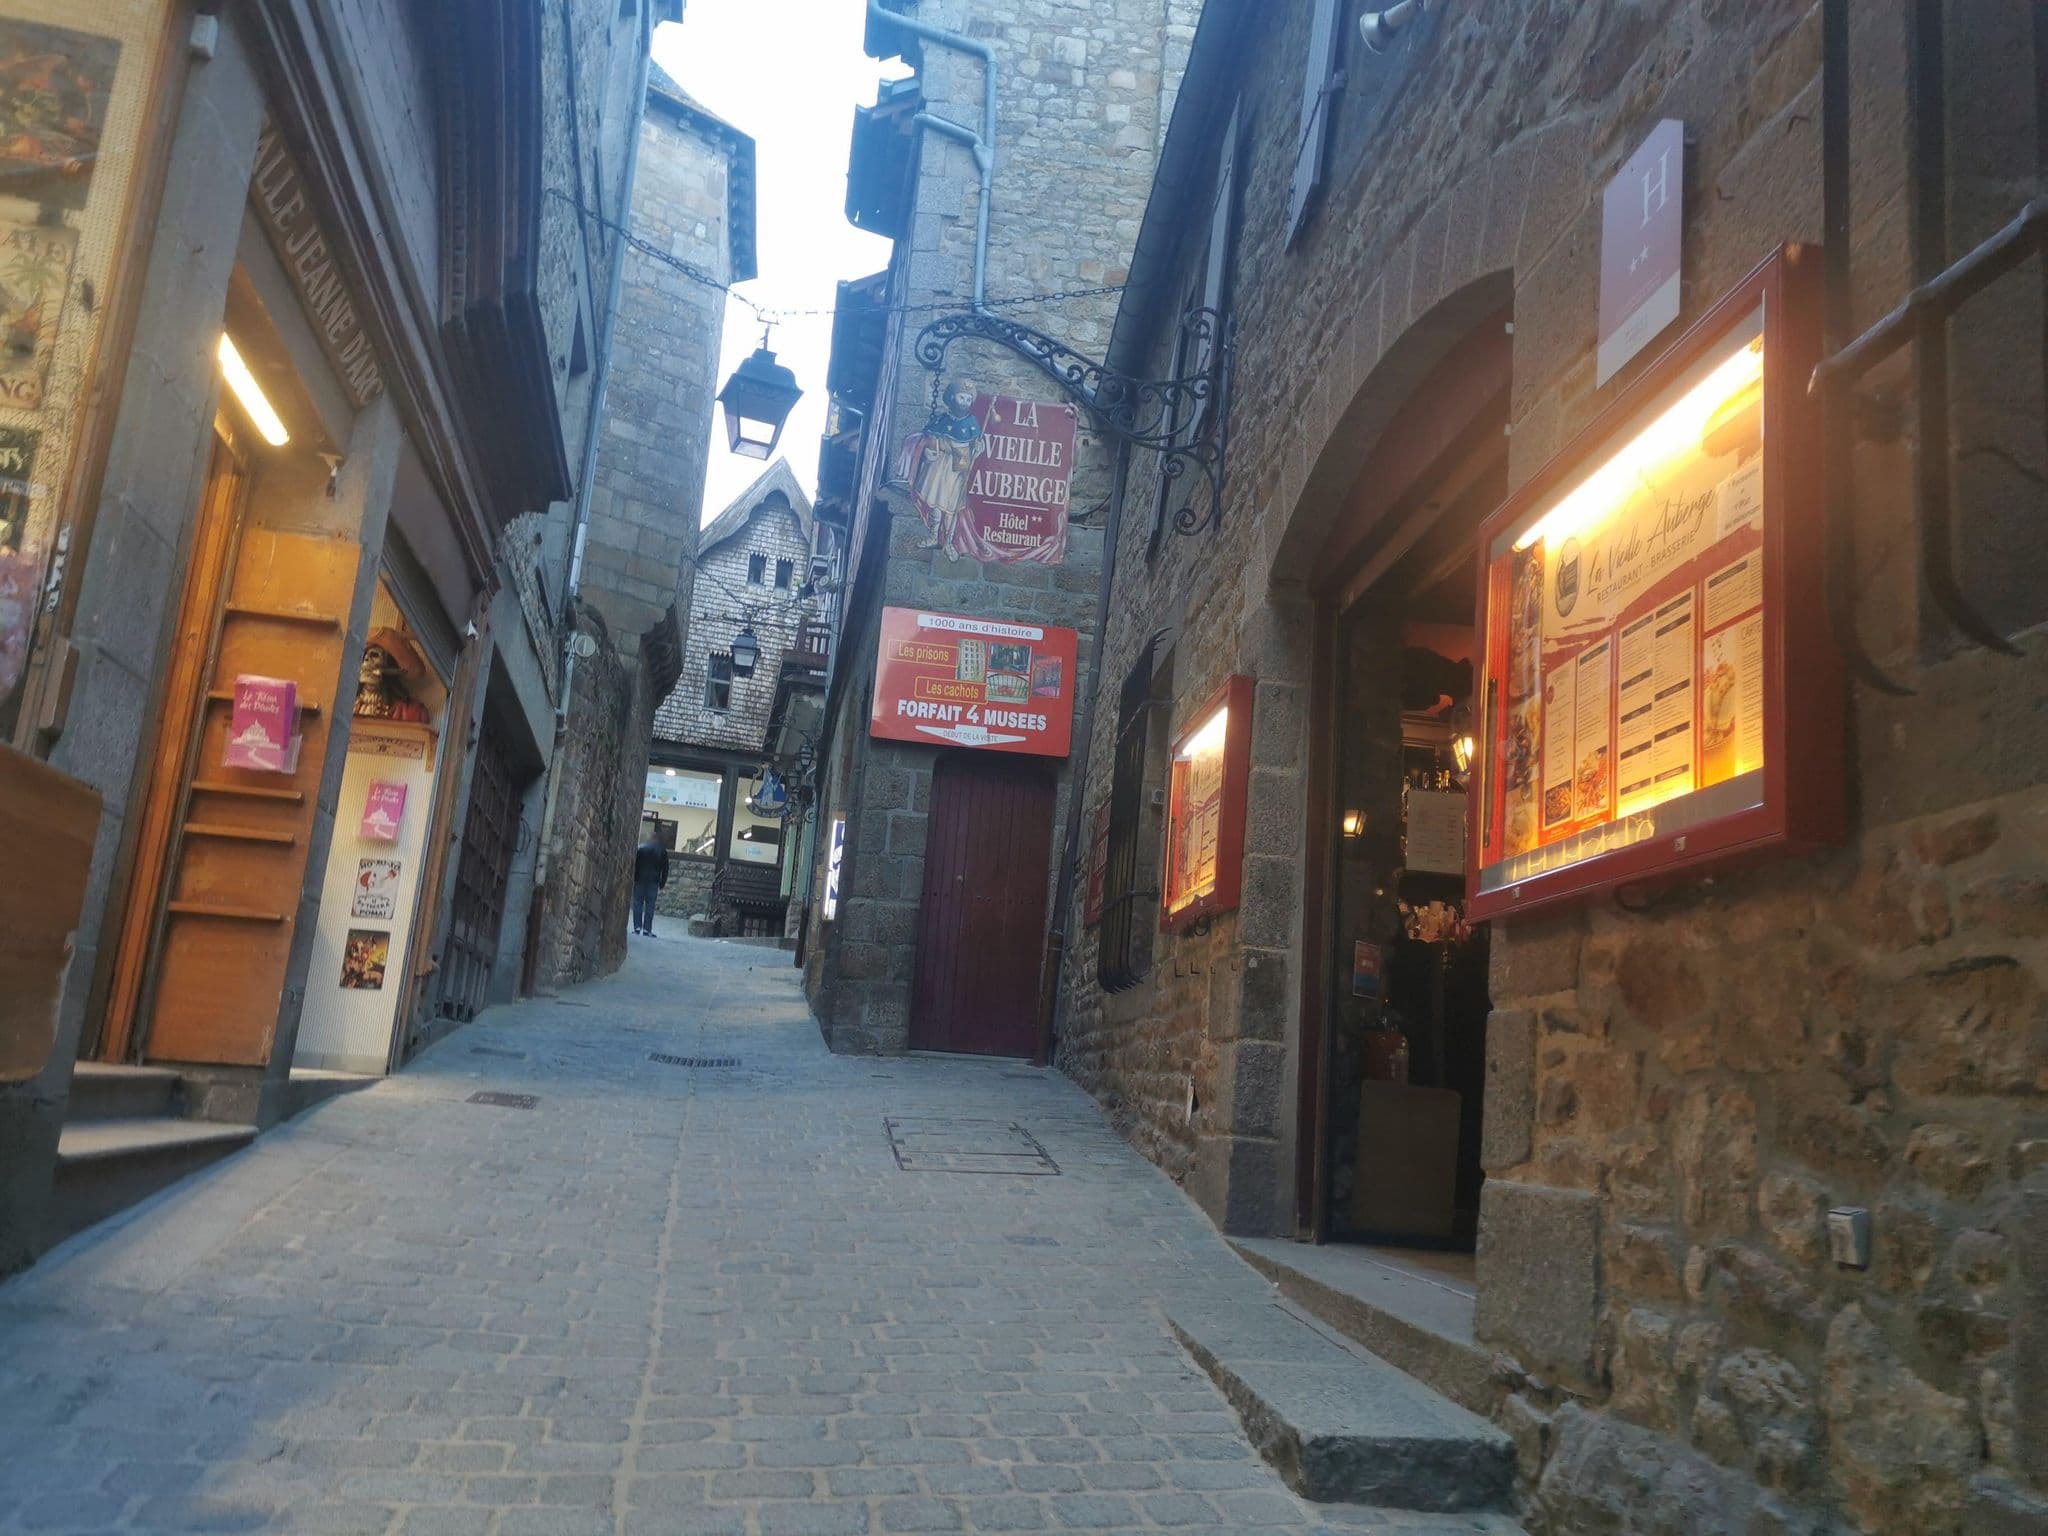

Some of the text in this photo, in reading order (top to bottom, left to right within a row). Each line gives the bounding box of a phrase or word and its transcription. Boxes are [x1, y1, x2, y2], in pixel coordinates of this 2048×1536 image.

[1640, 146, 1672, 230] H
[286, 223, 357, 344] JEANNE
[338, 328, 384, 406] D'ARC
[1013, 400, 1039, 428] LA
[984, 433, 1063, 468] VIEILLE
[968, 469, 1067, 505] AUBERGE
[983, 525, 1042, 548] Restaurant
[998, 512, 1029, 531] Hôtel
[1647, 489, 1714, 552] Auberge
[1597, 564, 1643, 603] RESTAURANT
[1650, 530, 1696, 568] BRASSERIE
[929, 618, 1032, 638] 1000 ans d'histoire
[898, 645, 949, 663] Les prisons
[926, 681, 979, 699] Les cachots
[897, 699, 1047, 731] FORFAIT 4 MUSEES
